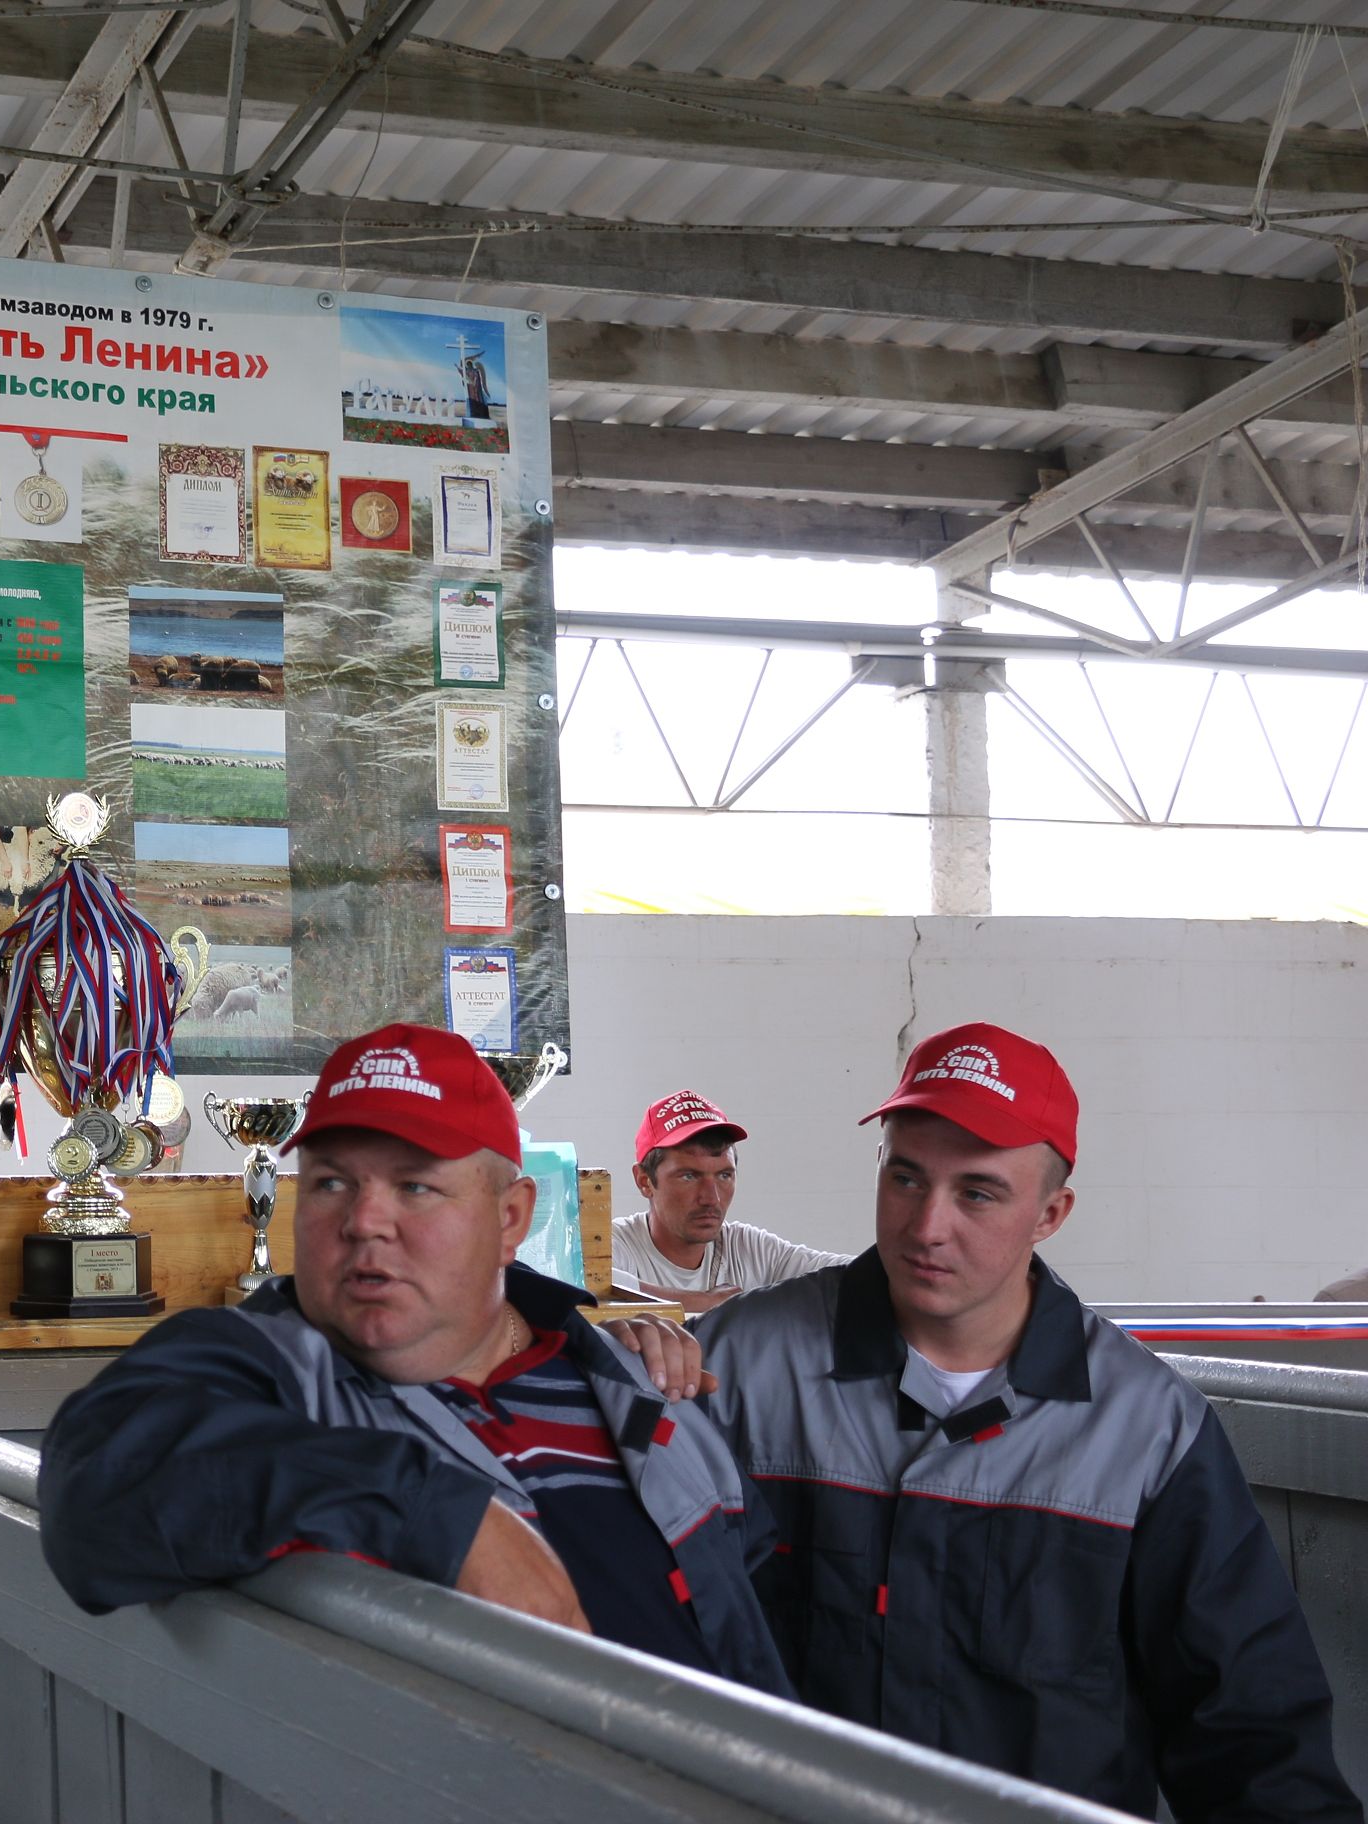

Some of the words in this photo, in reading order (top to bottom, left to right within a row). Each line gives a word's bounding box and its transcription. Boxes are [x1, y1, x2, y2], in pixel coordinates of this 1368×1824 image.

[121, 309, 132, 323] в
[139, 308, 192, 329] 1979
[197, 317, 214, 332] г.
[60, 325, 269, 380] Ленина»
[136, 386, 216, 414] края
[455, 991, 506, 1001] АТТЕСТАТ
[350, 1047, 420, 1076] СТАВРПОЛЬЕ
[362, 1058, 406, 1076] СПК
[948, 1055, 988, 1073] СПК
[329, 1075, 366, 1098] ПУТЬ
[368, 1075, 441, 1100] ЛЕНИНА
[913, 1068, 949, 1083] ПУТЬ
[950, 1068, 1016, 1102] ЛЕНИНА
[672, 1101, 706, 1113] СПК
[664, 1114, 690, 1131] ПУТЬ
